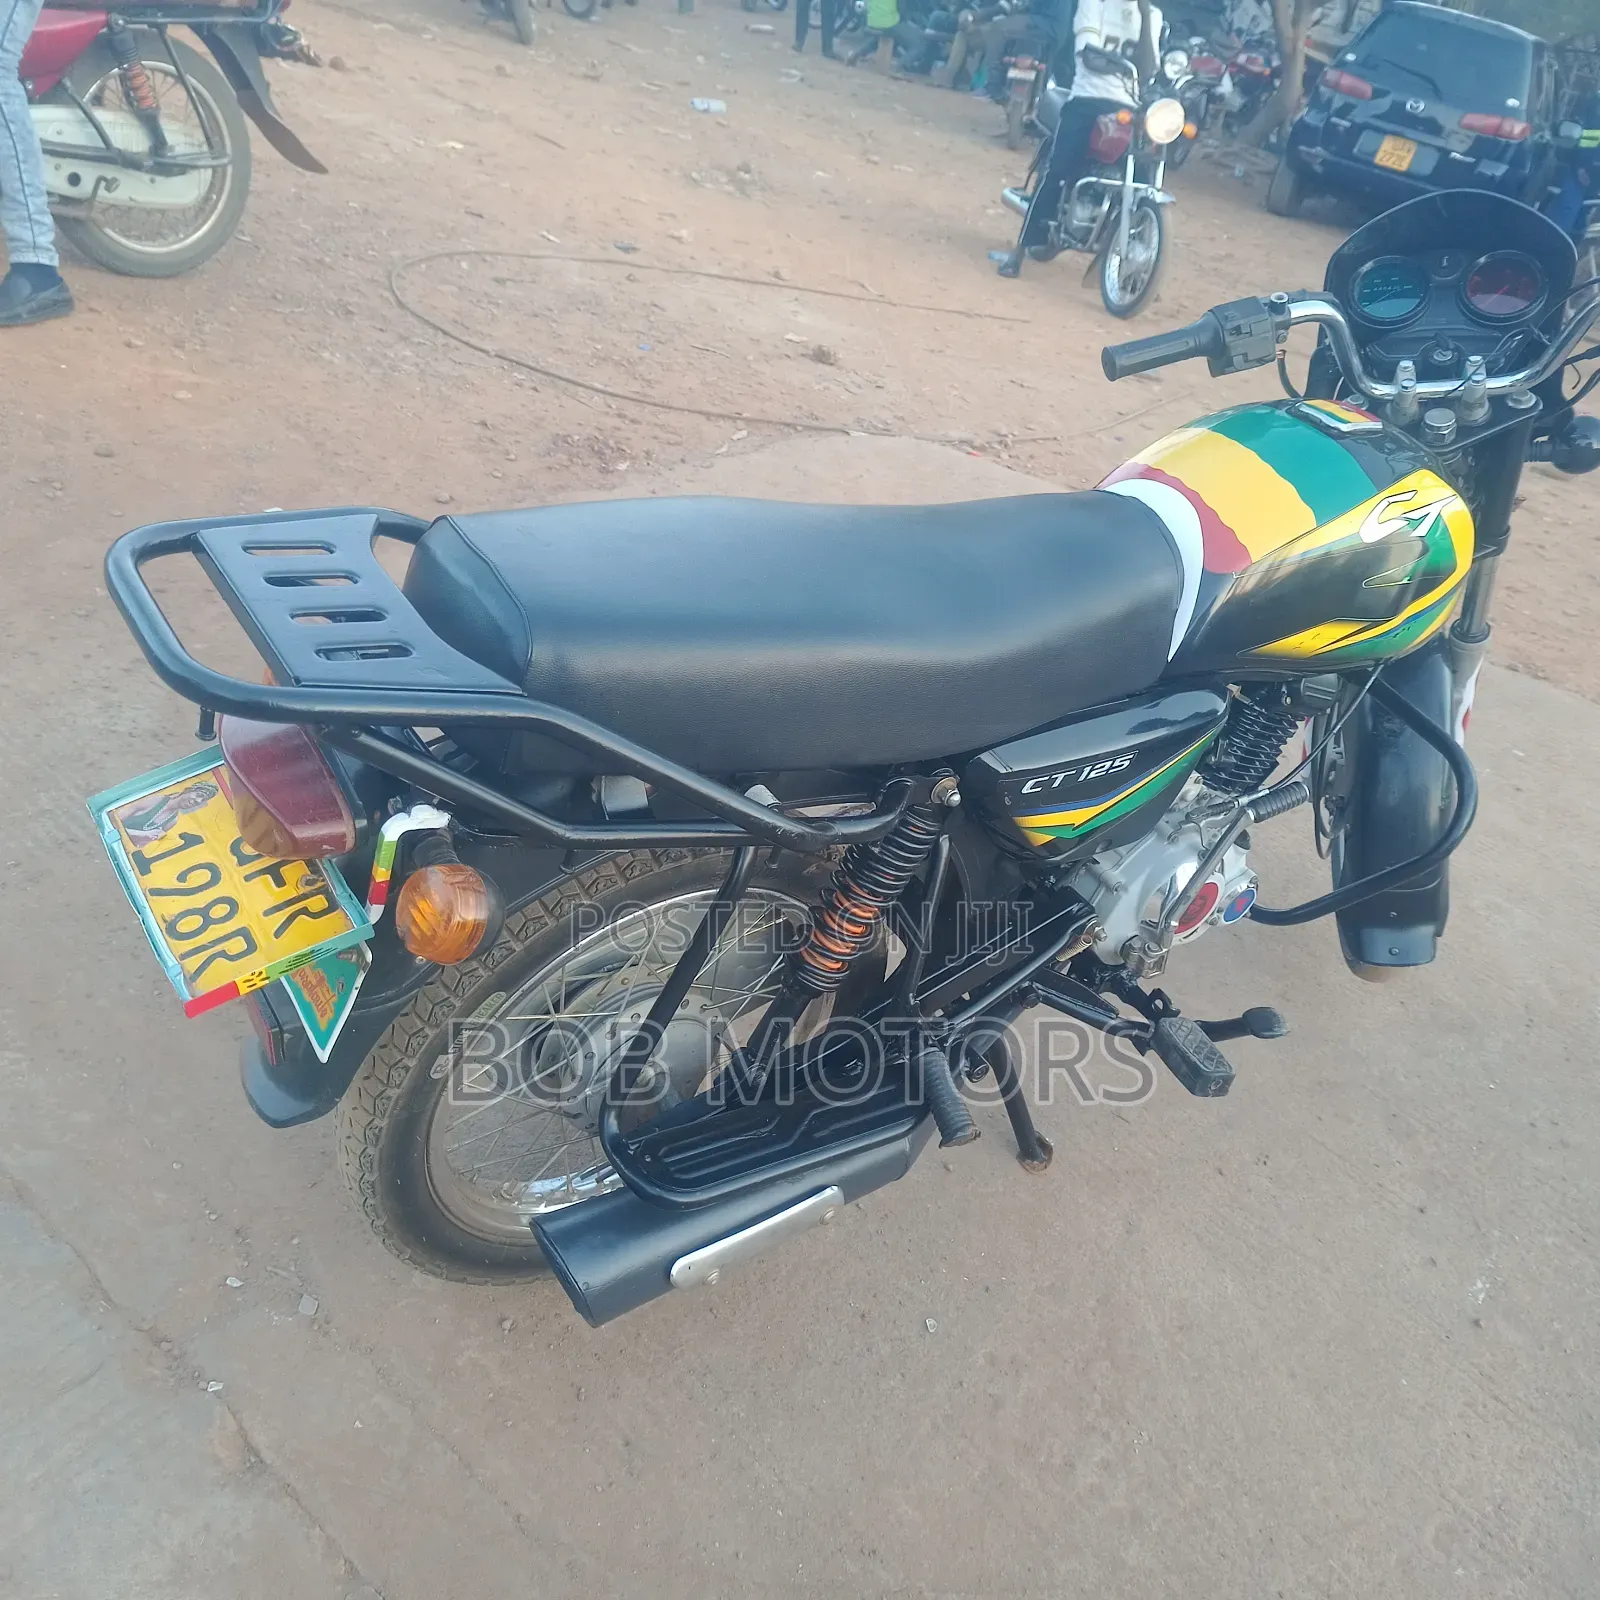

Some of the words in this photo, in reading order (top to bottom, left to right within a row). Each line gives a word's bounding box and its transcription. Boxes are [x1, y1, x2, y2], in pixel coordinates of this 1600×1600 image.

[1359, 489, 1458, 544] CT
[1020, 769, 1077, 795] CT
[1077, 752, 1136, 782] 125
[131, 831, 257, 984] 198R
